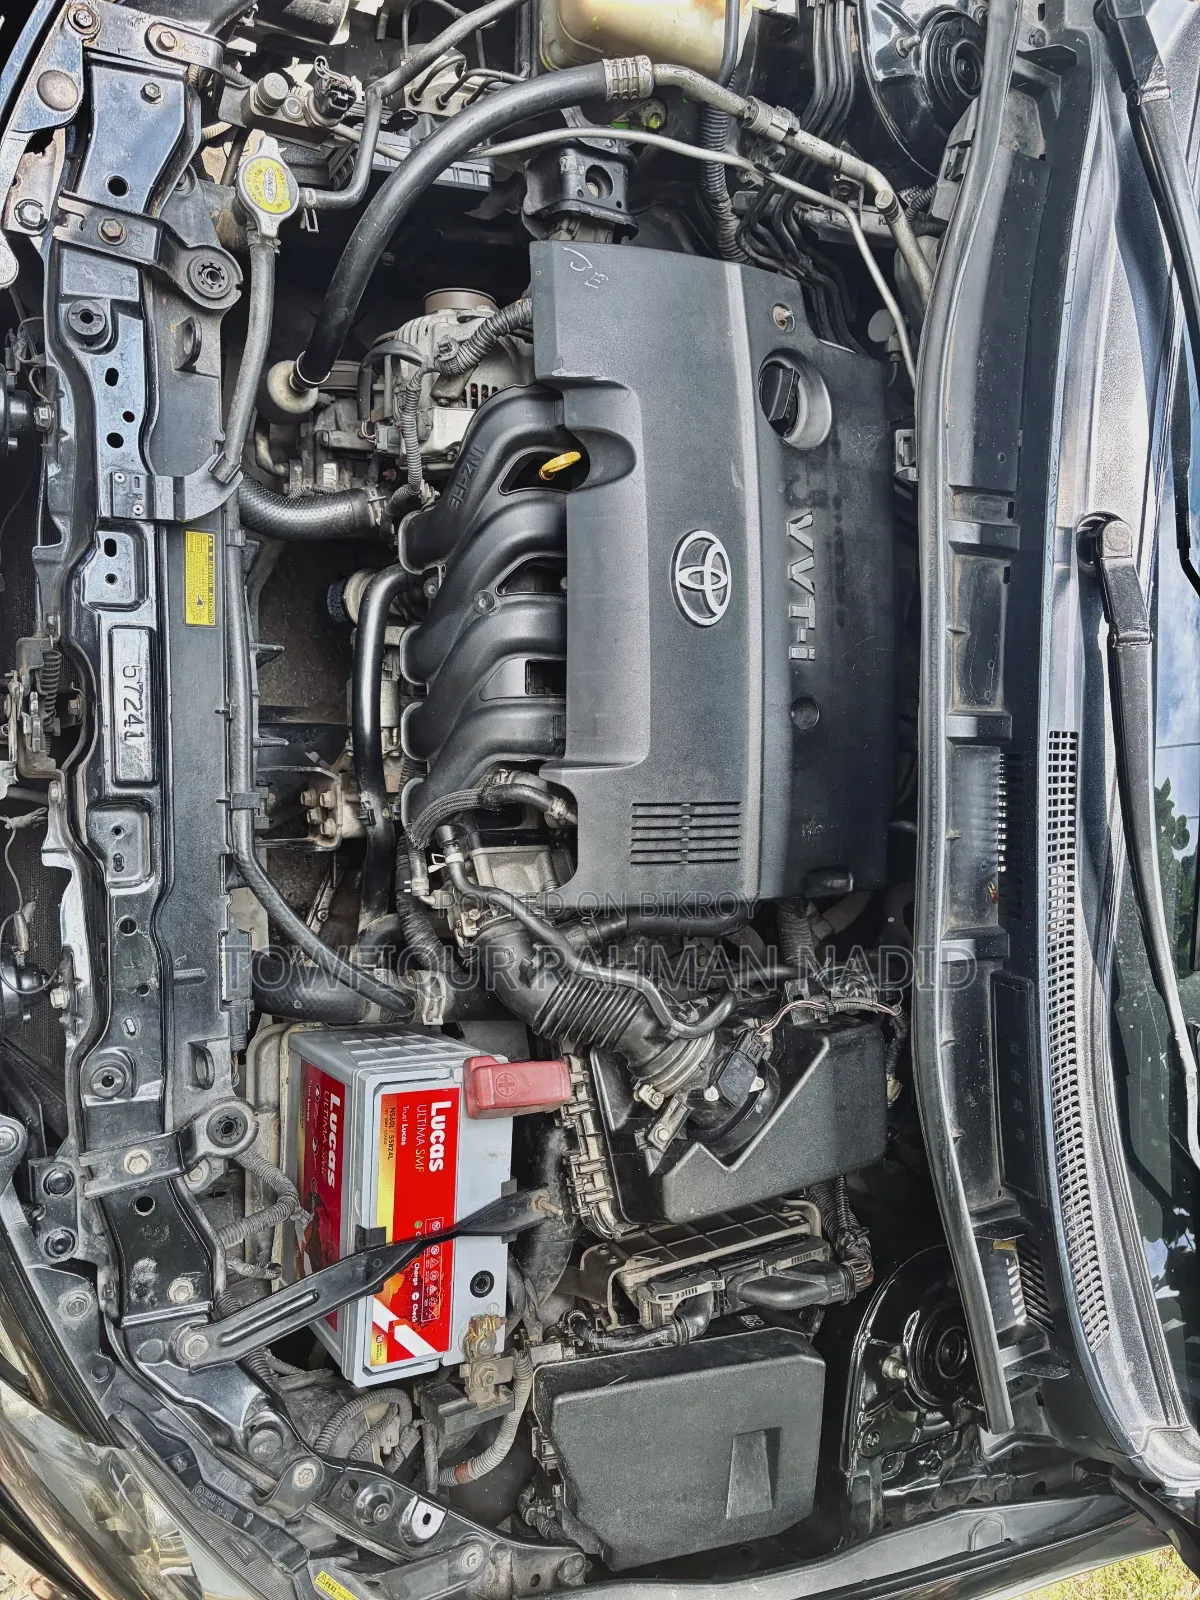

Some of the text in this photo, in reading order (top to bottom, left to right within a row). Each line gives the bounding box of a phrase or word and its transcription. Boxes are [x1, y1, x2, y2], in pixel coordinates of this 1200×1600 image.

[448, 446, 485, 512] 1NZ-FE
[787, 510, 816, 660] VVT-i
[122, 665, 146, 741] 57241
[321, 1090, 330, 1143] ULTIMA
[327, 1092, 341, 1189] Lucas
[400, 1105, 410, 1146] Trust Lucas
[415, 1104, 427, 1173] ULTIMA SMF
[429, 1101, 452, 1172] Lucas
[411, 1303, 419, 1323] Check
